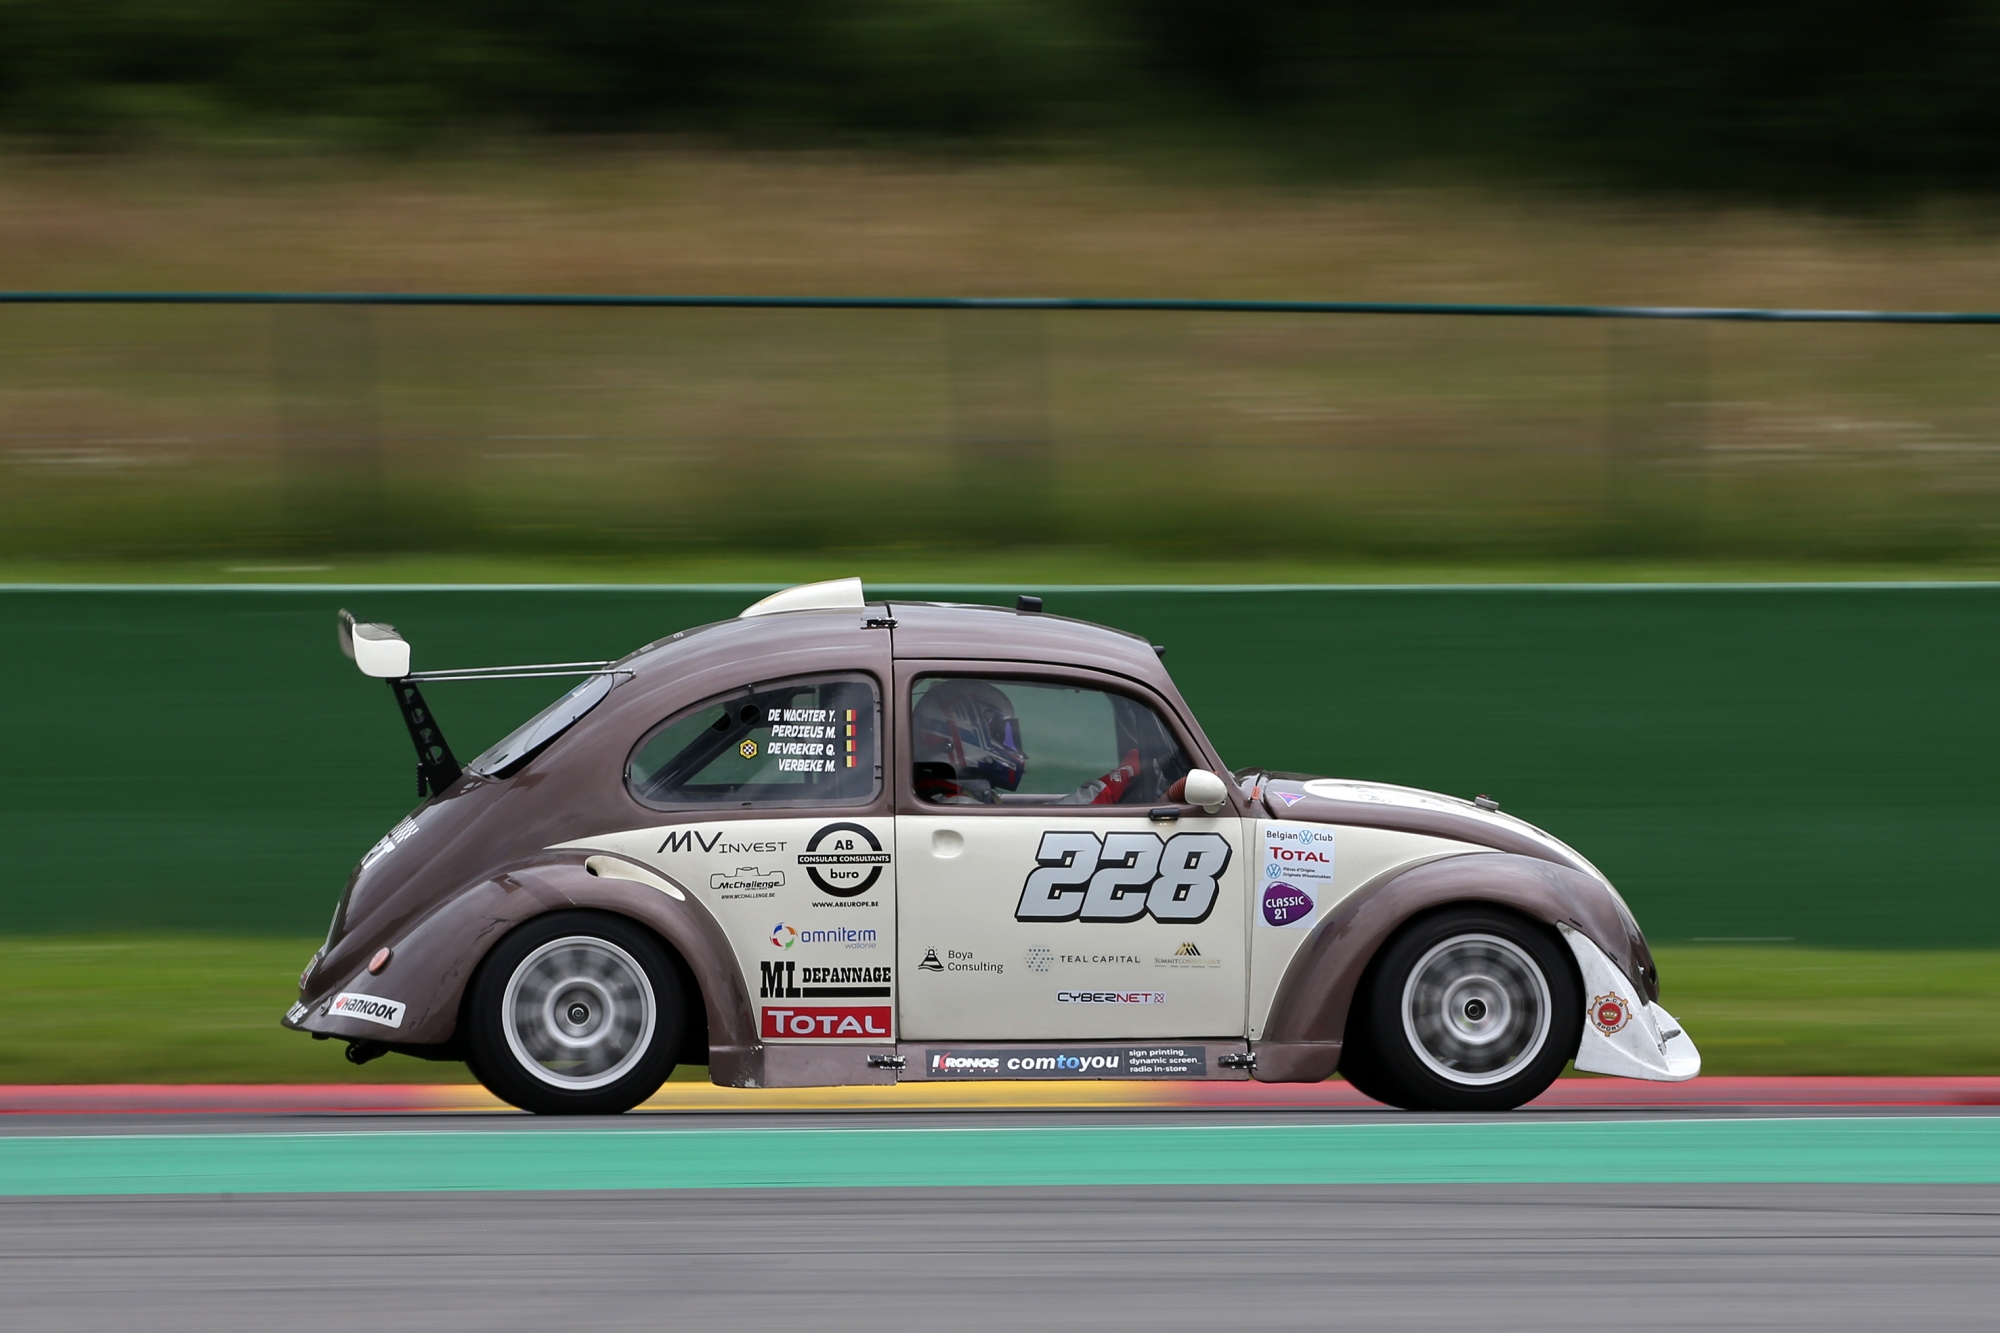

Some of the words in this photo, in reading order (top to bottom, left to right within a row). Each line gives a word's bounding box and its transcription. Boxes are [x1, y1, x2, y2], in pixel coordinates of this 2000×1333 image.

[768, 709, 781, 721] DE
[783, 709, 825, 722] WACHTER
[828, 710, 836, 722] Y.
[771, 725, 823, 738] PERDIEUS
[825, 727, 836, 738] M.
[767, 742, 823, 755] DEVREKER
[826, 744, 835, 756] Q.
[778, 759, 824, 771] VERBEKE
[825, 760, 836, 772] M.
[1266, 830, 1298, 841] Belgian
[1314, 833, 1333, 842] Club
[834, 839, 854, 851] AB
[799, 855, 838, 863] CONSULAR
[1269, 846, 1330, 863] TOTAL
[830, 868, 859, 879] buro
[1014, 831, 1233, 924] 228
[720, 881, 780, 889] McChallenge
[721, 892, 776, 900] WWW.MCCHALLENGE.BE
[1265, 896, 1304, 908] CLASSIC
[1274, 908, 1287, 920] 21
[801, 927, 876, 943] omniterm
[948, 950, 973, 961] Boya
[1060, 955, 1088, 963] TEAL
[1092, 955, 1141, 963] CAPITAL
[947, 962, 1004, 974] Consulting
[760, 961, 801, 998] ML
[802, 967, 891, 983] DEPANNAGE
[767, 1010, 886, 1034] TOTAL
[1597, 1022, 1620, 1031] SPORT
[1129, 1049, 1147, 1057] sign
[932, 1052, 1000, 1069] KRONOS
[1007, 1054, 1119, 1072] comtoyou
[1129, 1057, 1167, 1065] dynamic
[1129, 1065, 1153, 1073] radio
